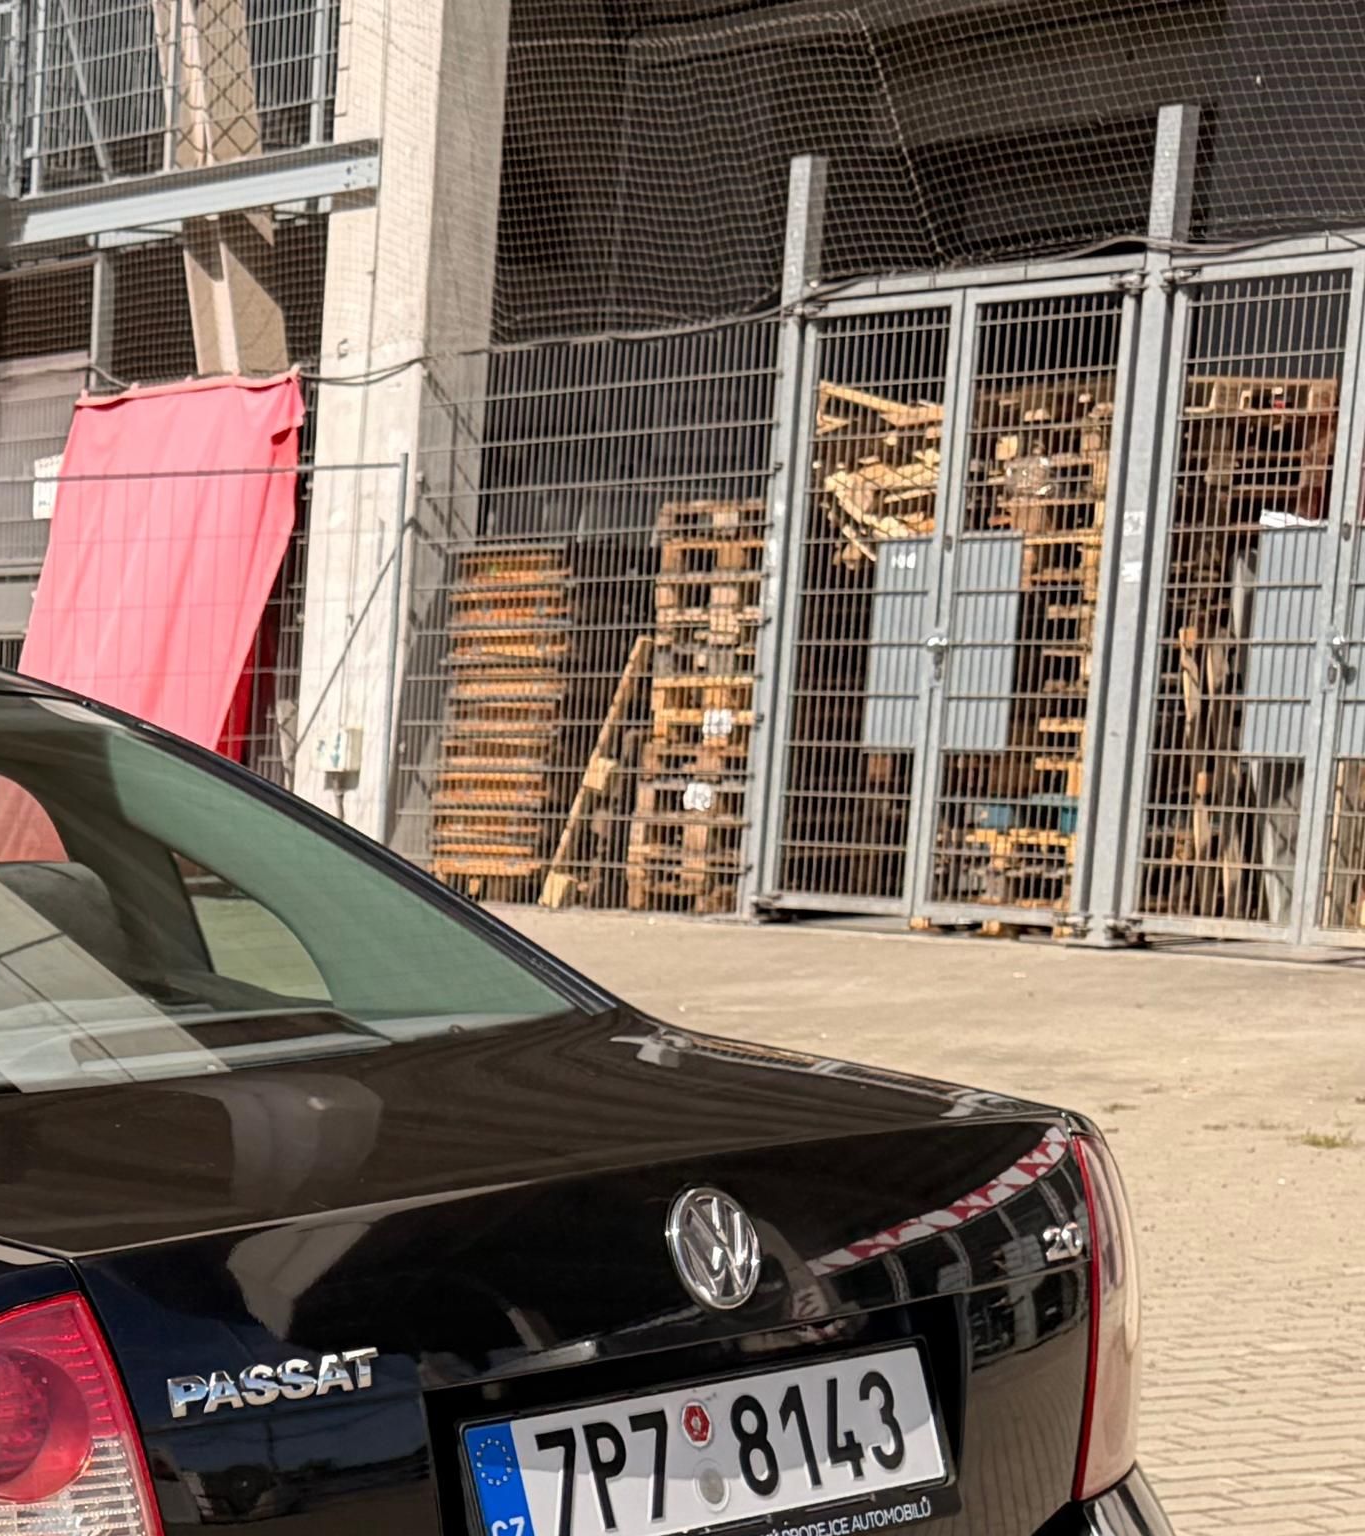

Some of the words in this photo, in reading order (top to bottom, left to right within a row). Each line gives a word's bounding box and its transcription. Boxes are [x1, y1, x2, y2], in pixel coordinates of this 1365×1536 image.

[167, 1346, 379, 1418] PASSAT
[730, 1370, 906, 1498] 8143
[851, 1495, 932, 1533] AUTOMOBILŮ
